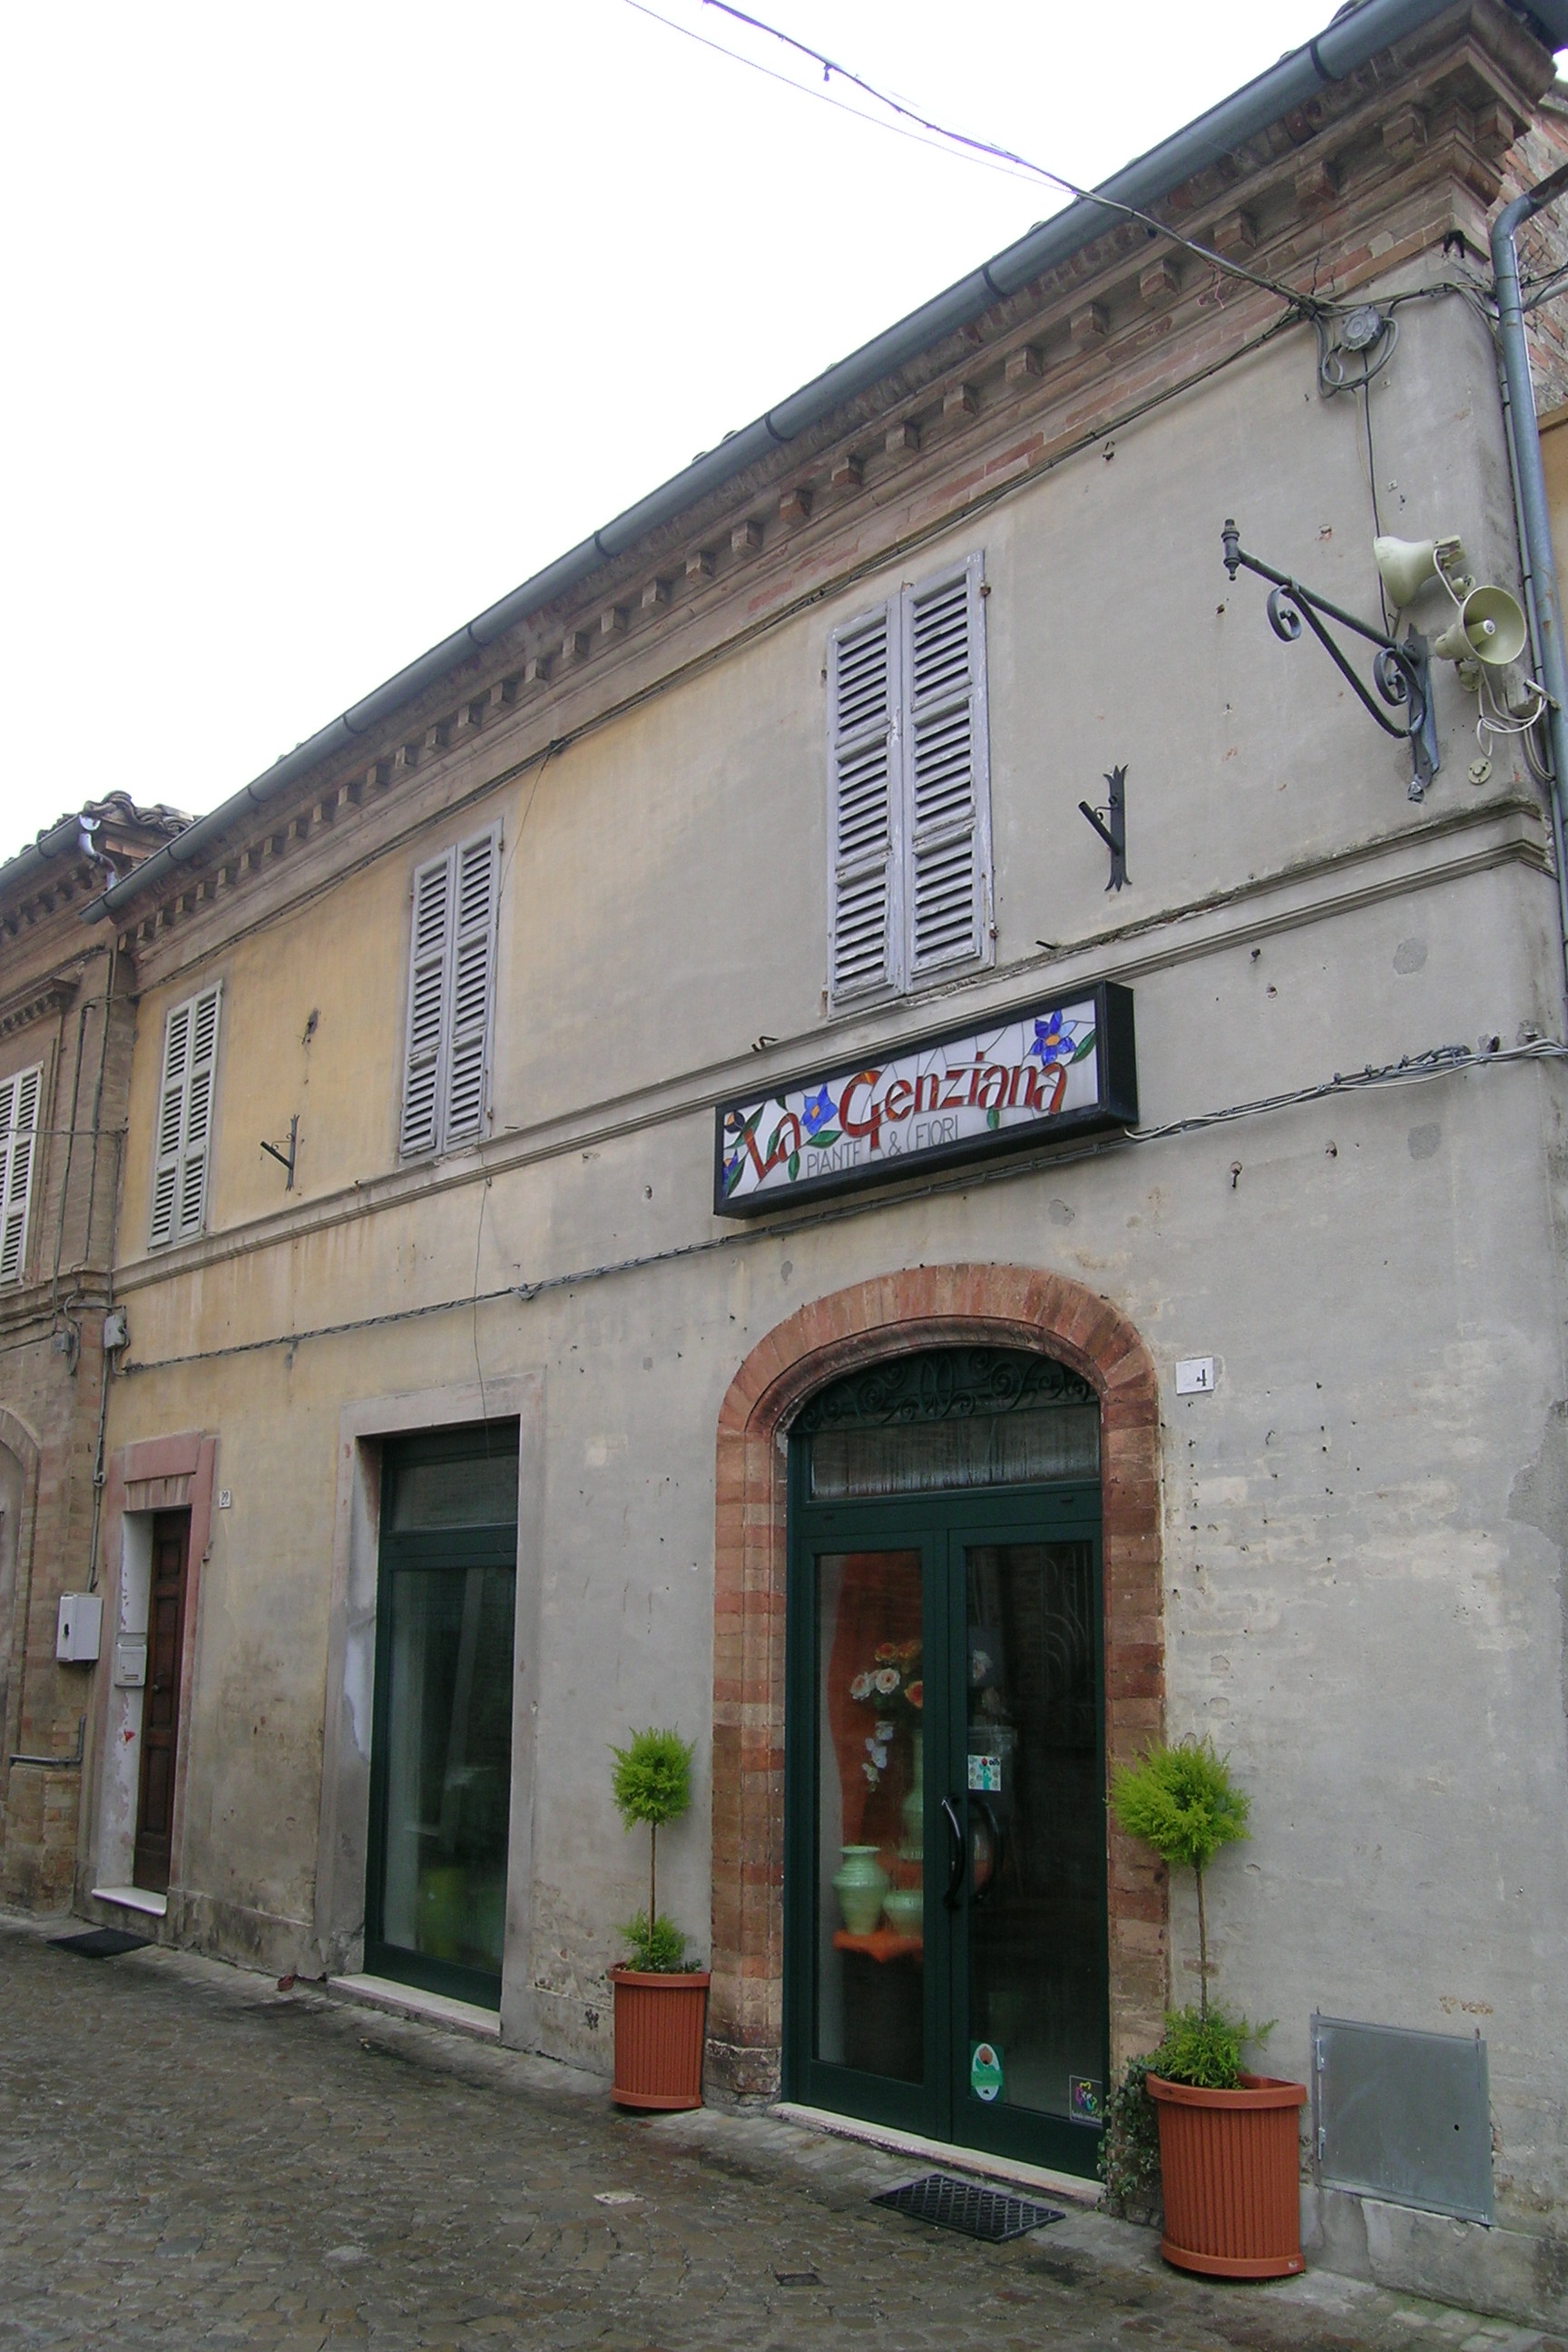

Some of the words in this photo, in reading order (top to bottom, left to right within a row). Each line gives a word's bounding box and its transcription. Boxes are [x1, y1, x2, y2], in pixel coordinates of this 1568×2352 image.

[743, 1112, 801, 1180] La
[838, 1051, 1068, 1150] Genziana
[887, 1130, 902, 1158] &
[915, 1114, 959, 1151] FIORI
[1196, 1368, 1208, 1387] 4
